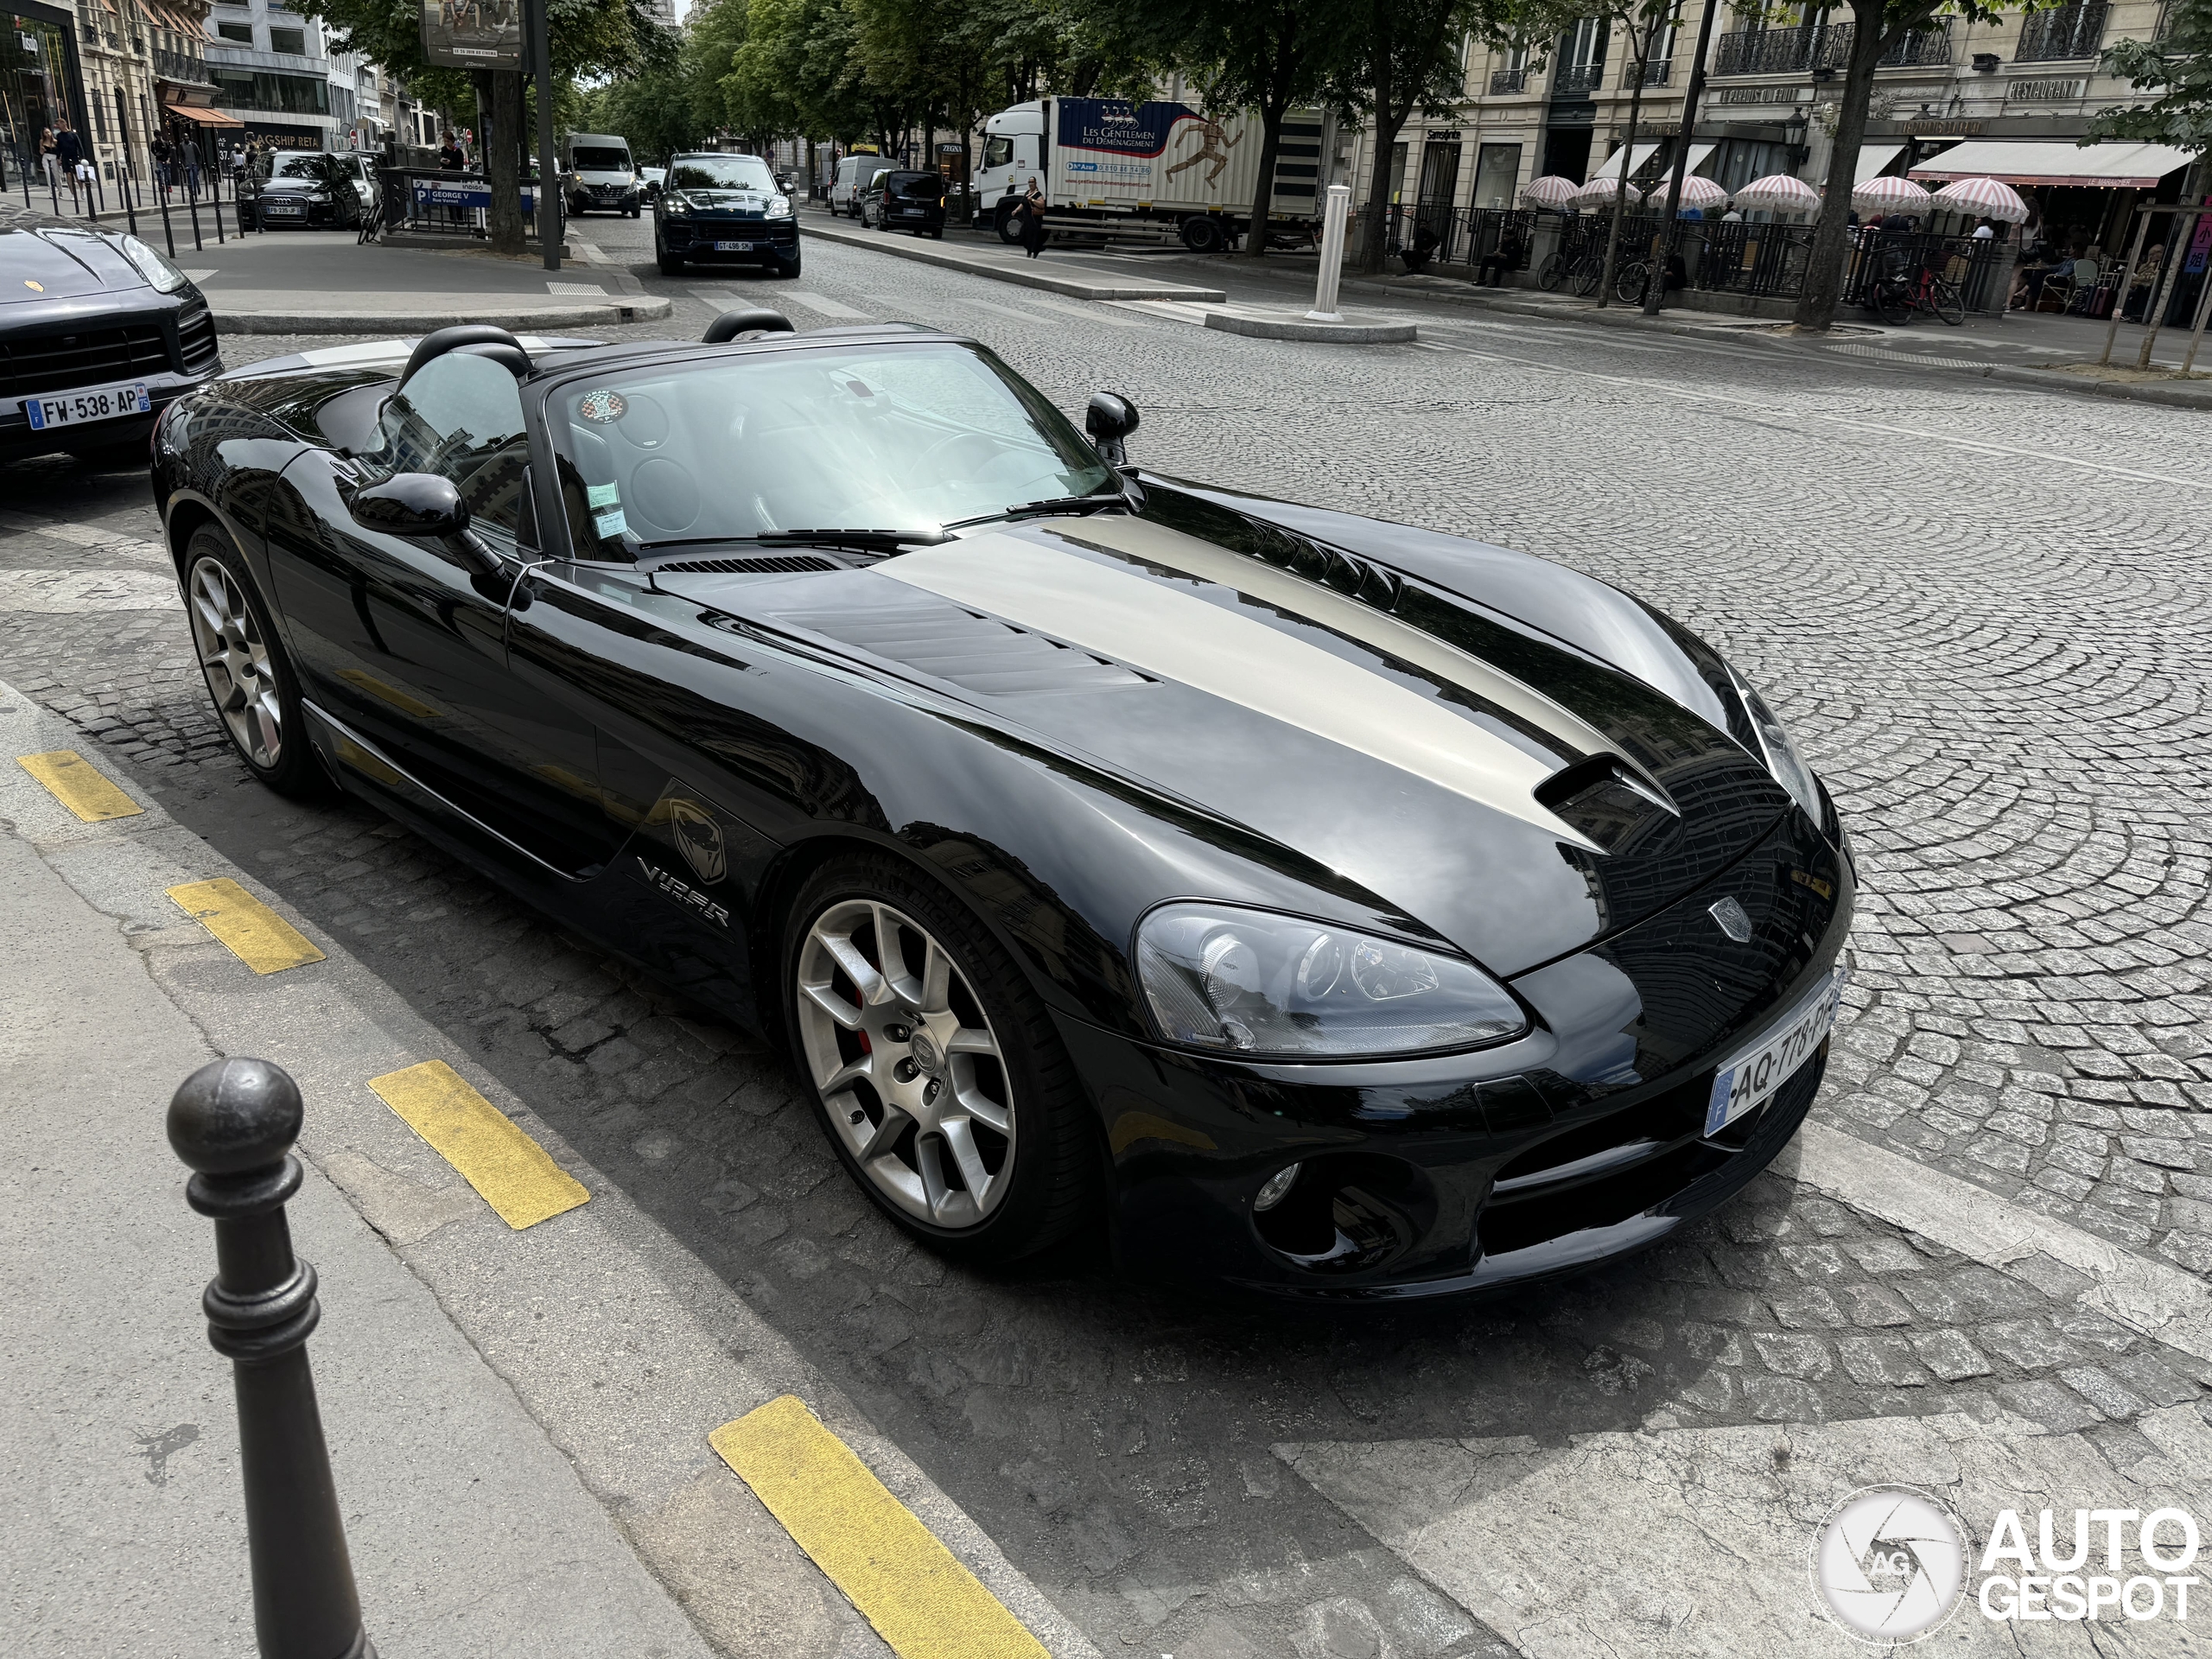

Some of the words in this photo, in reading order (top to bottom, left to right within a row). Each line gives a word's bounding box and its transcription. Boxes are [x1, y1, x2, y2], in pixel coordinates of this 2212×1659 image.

[1729, 89, 1761, 103] PARADIS
[1760, 89, 1774, 102] DU
[1773, 88, 1798, 102] FRUIT
[2009, 80, 2080, 99] RESTAURANT
[1084, 126, 1099, 137] LES
[1101, 128, 1155, 139] GENTLEMEN
[417, 190, 426, 201] P
[432, 191, 462, 200] GEORGE
[43, 390, 137, 423] FW-538-AP
[139, 398, 149, 408] 75
[636, 855, 729, 928] VIPER
[1714, 1103, 1724, 1122] F
